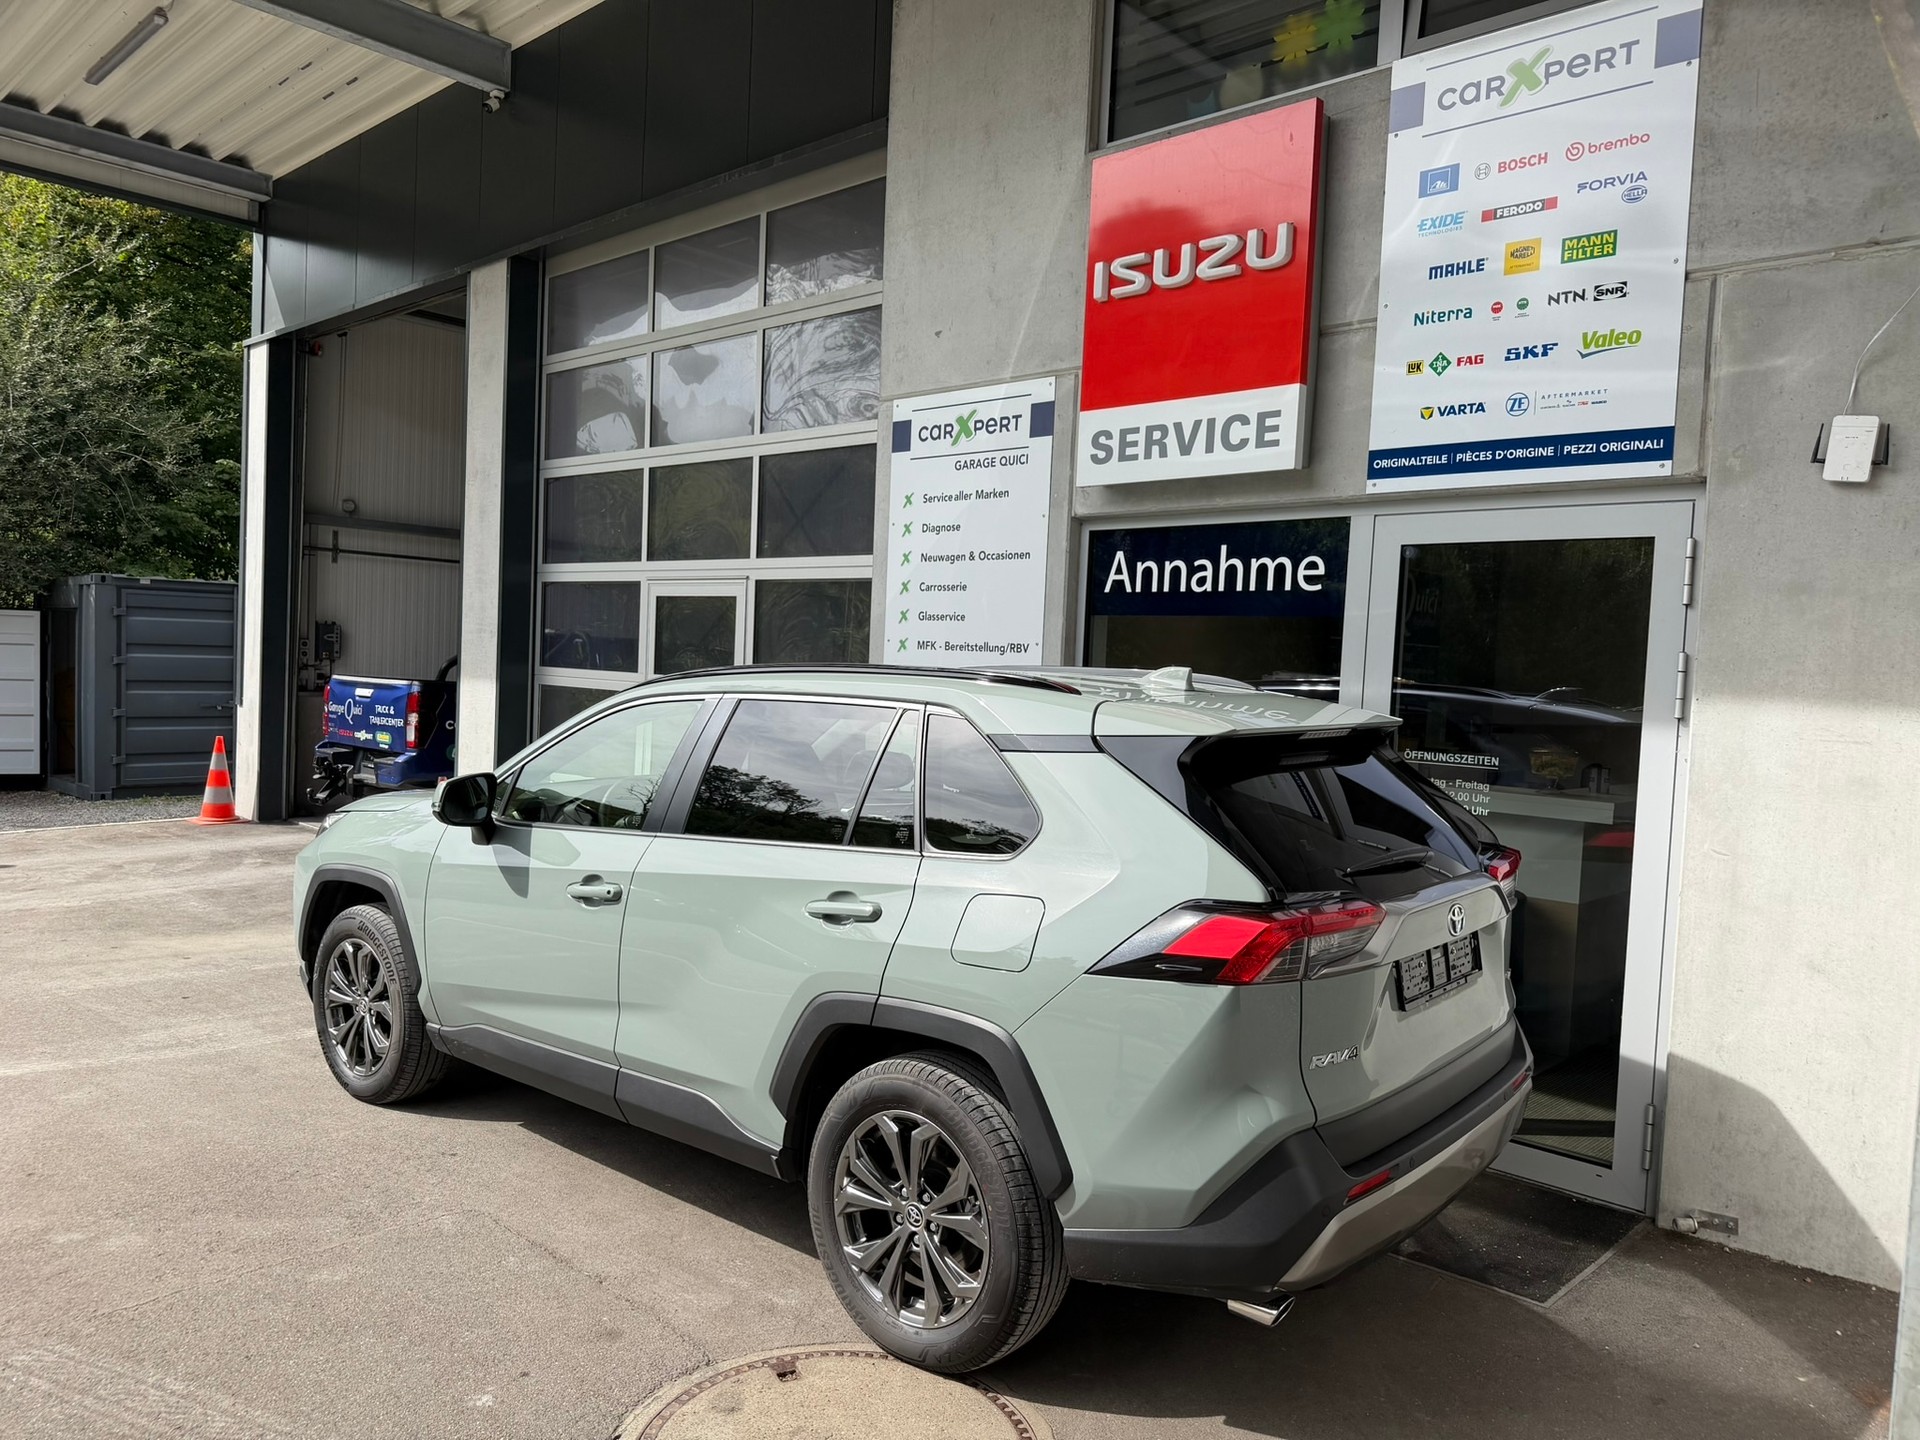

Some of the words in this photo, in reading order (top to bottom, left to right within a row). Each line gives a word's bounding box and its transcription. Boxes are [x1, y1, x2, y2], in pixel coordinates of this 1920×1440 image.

[1588, 133, 1650, 154] brembo
[1497, 152, 1548, 174] BOSCH
[1577, 171, 1648, 194] FORVIA
[1624, 189, 1648, 199] HELLA
[1496, 202, 1543, 219] FERODO
[1417, 211, 1466, 232] EXIDE
[1418, 226, 1463, 238] TECHNOLOGIES
[1565, 232, 1614, 250] MANN
[1564, 244, 1614, 261] FILTER
[1093, 222, 1295, 303] ISUZU
[1429, 257, 1485, 280] MAHLE
[1548, 288, 1587, 306] NTN
[1595, 285, 1624, 298] SNR
[1413, 306, 1473, 326] Niterra
[1581, 329, 1642, 351] Valeo
[1456, 354, 1485, 367] FAG
[1504, 342, 1559, 362] SKF
[1541, 388, 1609, 400] AFTERMARKET
[1437, 402, 1486, 418] VARTA
[1508, 396, 1528, 412] ZF
[1090, 409, 1282, 466] SERVICE
[1456, 446, 1493, 463] PIÈCES
[1563, 441, 1597, 456] PEZZI
[1599, 438, 1665, 454] ORIGINALI
[954, 457, 997, 471] GARAGE
[999, 454, 1029, 468] QUICI
[1373, 453, 1448, 469] ORIGINALTEILE
[922, 492, 953, 504] Service
[953, 490, 973, 502] aller
[975, 488, 1010, 500] Marken
[921, 523, 961, 536] Diagnose
[920, 552, 966, 565] Neuwagen
[968, 551, 976, 561] &
[978, 550, 1031, 562] Occasionen
[1104, 544, 1326, 593] Annahme
[919, 581, 968, 593] Carrosserie
[917, 611, 966, 622] Glasservice
[917, 640, 937, 651] MFK
[944, 641, 1030, 656] Bereitstellung/RBV
[1404, 748, 1499, 767] ÖFFNUNGSZEITEN
[1455, 779, 1490, 793] Freitag
[1472, 793, 1491, 804] Uhr
[1471, 806, 1490, 817] Uhr
[357, 920, 398, 985] BRIDGESTONE
[1309, 1045, 1359, 1070] RAV4
